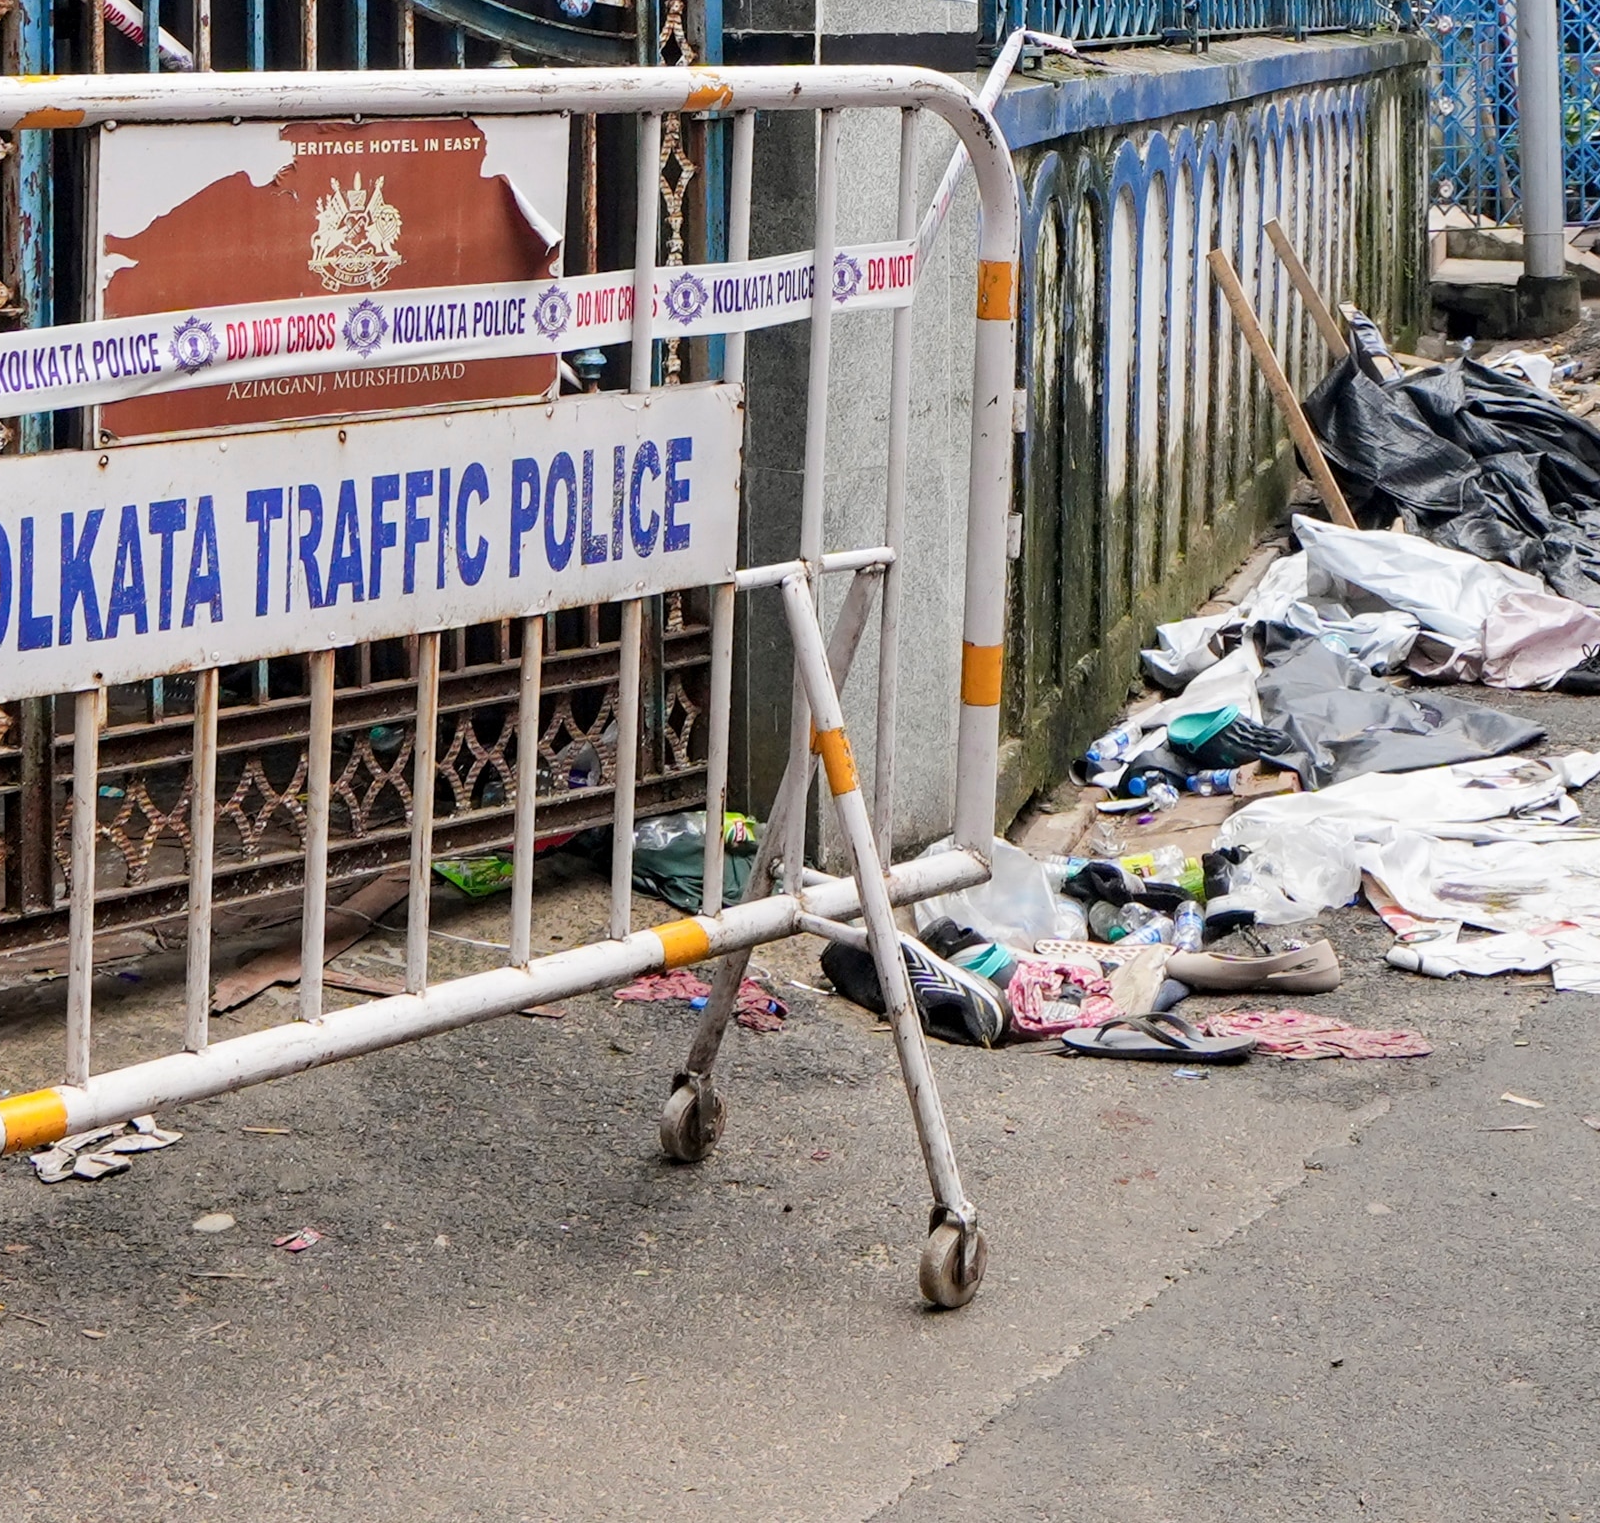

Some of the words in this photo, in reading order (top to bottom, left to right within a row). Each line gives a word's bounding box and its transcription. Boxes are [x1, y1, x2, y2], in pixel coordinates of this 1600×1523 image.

[369, 139, 419, 154] HOTEL
[424, 137, 439, 152] IN
[444, 136, 481, 151] EAST
[712, 272, 774, 315] KOLKATA
[777, 264, 815, 307] POLICE
[867, 257, 885, 292] DO
[887, 253, 913, 290] NOT
[392, 302, 467, 344] KOLKATA
[473, 297, 526, 337] POLICE
[576, 291, 591, 328] DO
[594, 287, 617, 325] NOT
[618, 283, 658, 321] CRS
[92, 332, 162, 378] POLICE
[226, 321, 249, 362] DO
[252, 317, 283, 358] NOT
[286, 312, 336, 354] CROSS
[227, 375, 326, 402] AZIMGANJ,
[332, 361, 466, 392] MURSHIDABAD
[246, 461, 490, 617] TRAFFIC
[508, 436, 695, 579] POLICE
